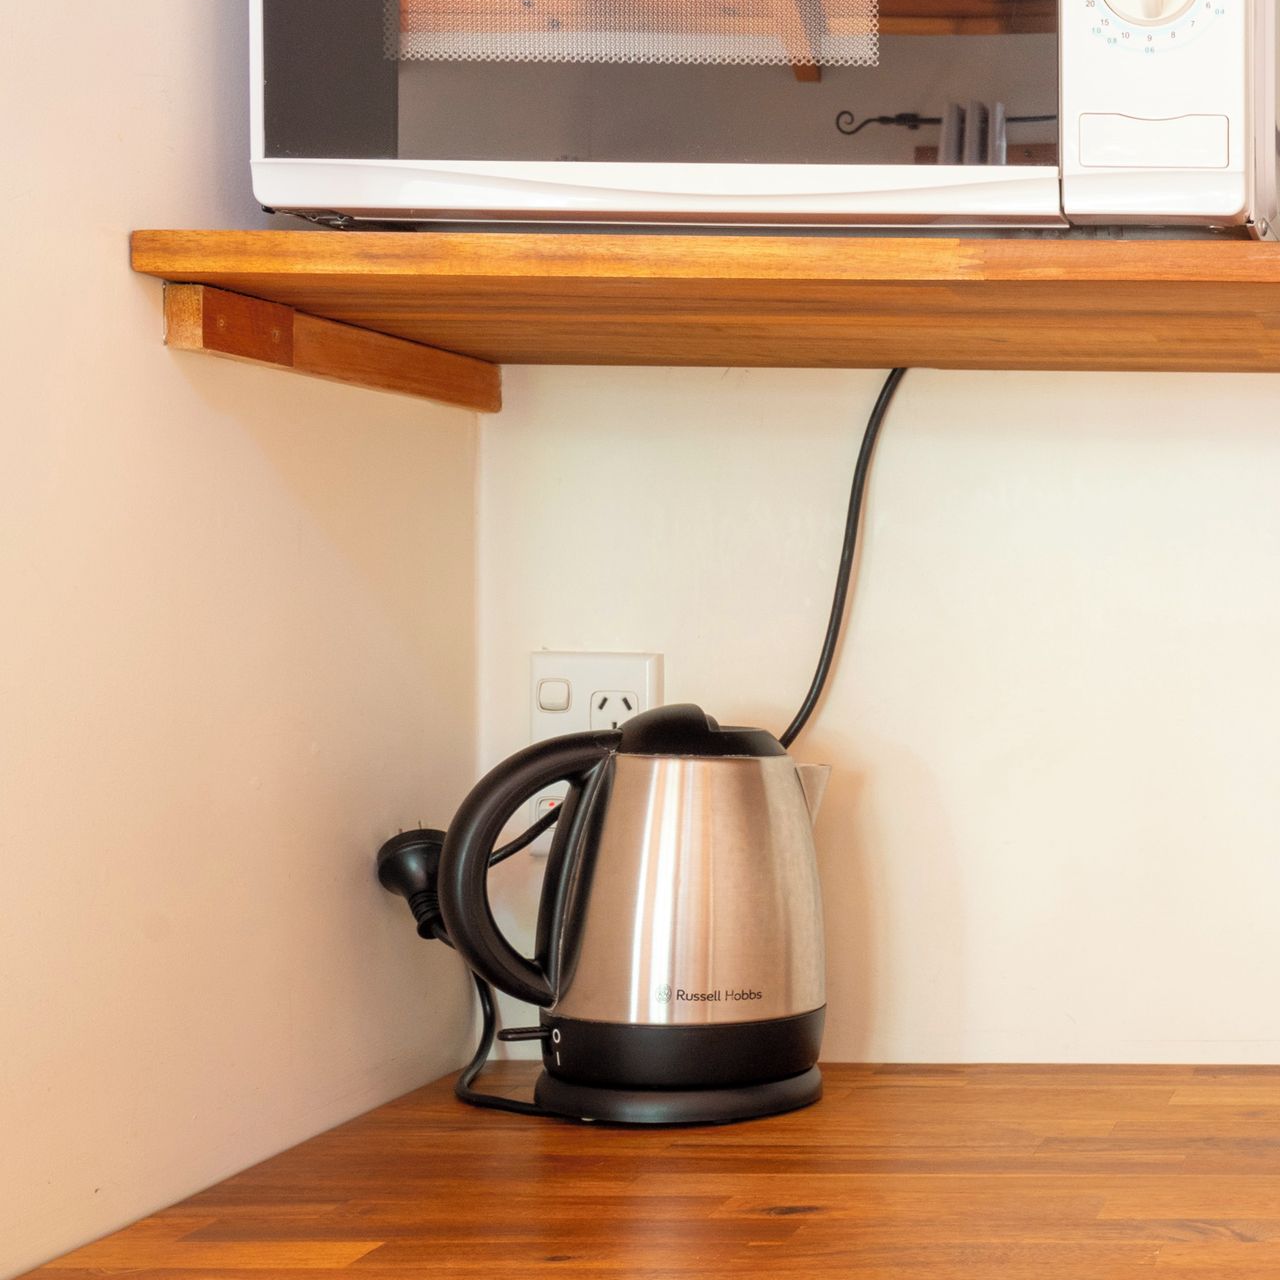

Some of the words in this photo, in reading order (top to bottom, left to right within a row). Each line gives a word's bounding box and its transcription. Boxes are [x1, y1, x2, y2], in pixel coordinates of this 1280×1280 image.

[1085, 0, 1095, 8] 20
[676, 989, 721, 1001] Russell
[725, 989, 762, 1001] Hobbs
